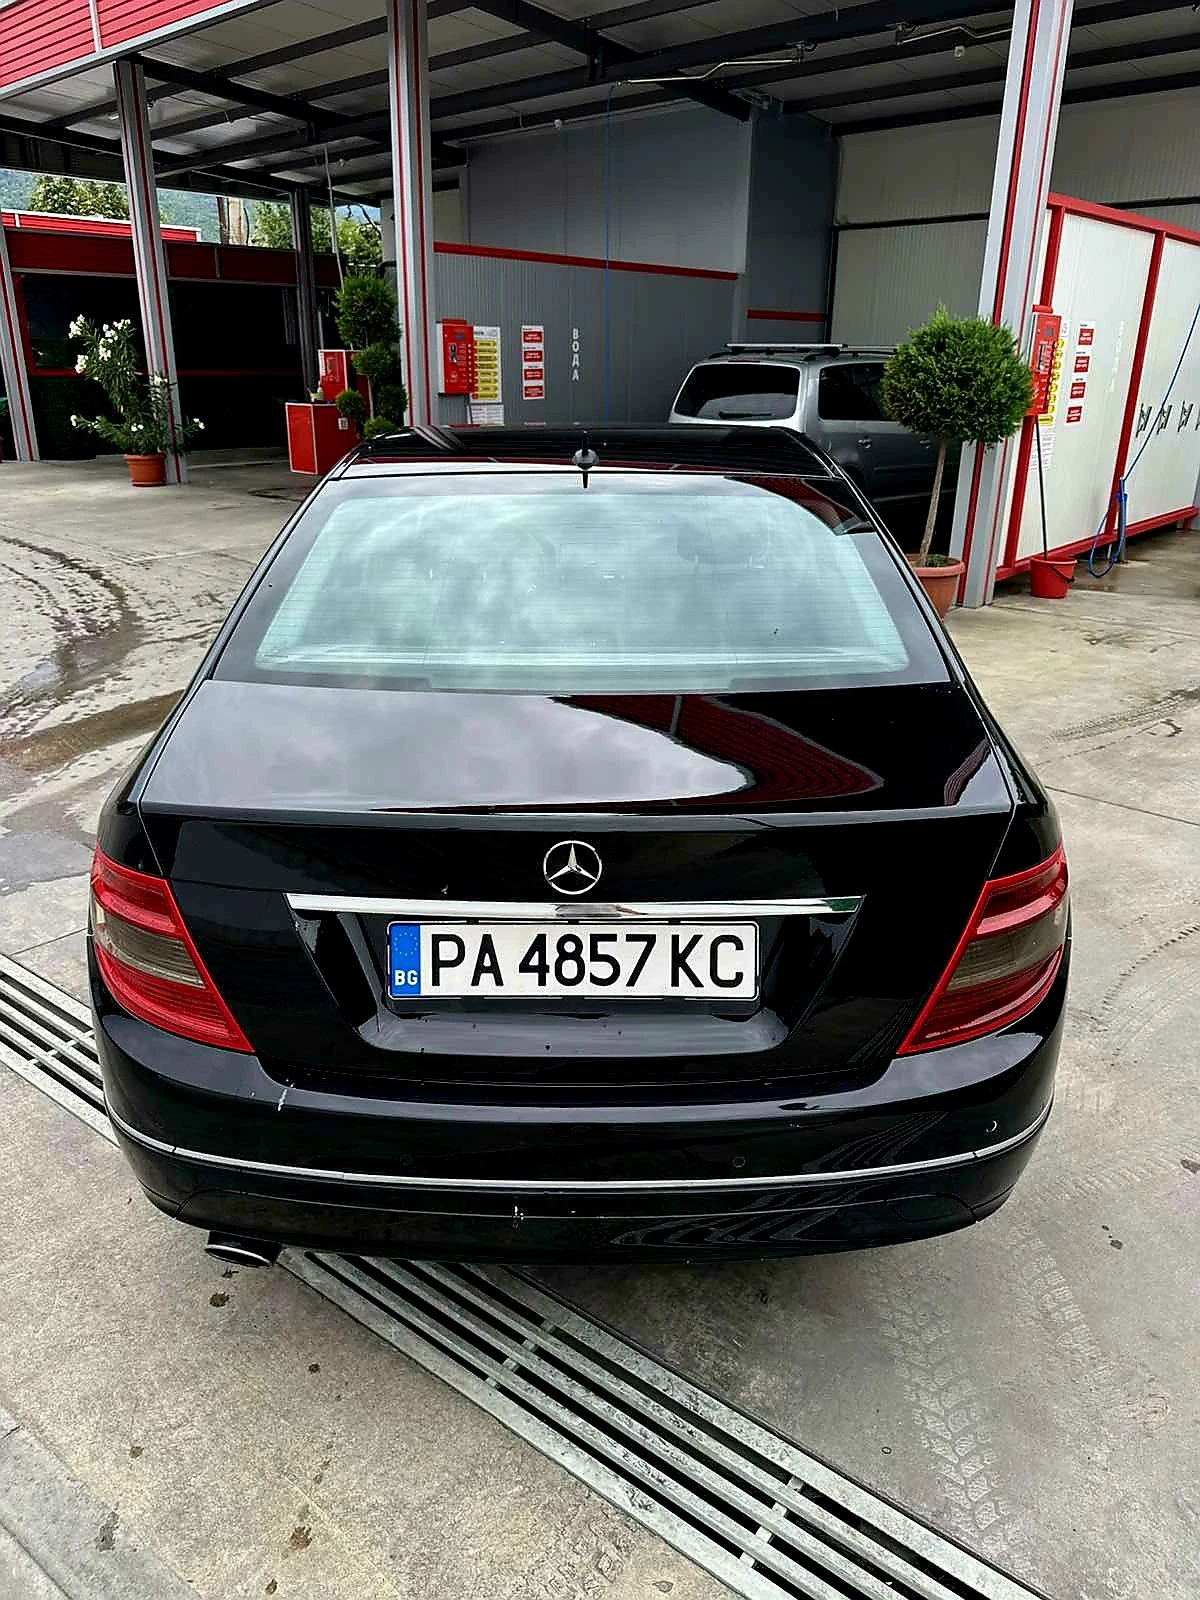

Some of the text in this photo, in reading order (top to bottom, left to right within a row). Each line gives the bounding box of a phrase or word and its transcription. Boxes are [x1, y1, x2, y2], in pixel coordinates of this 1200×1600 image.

[431, 933, 744, 988] PA 4857 KC
[394, 971, 418, 985] BG
